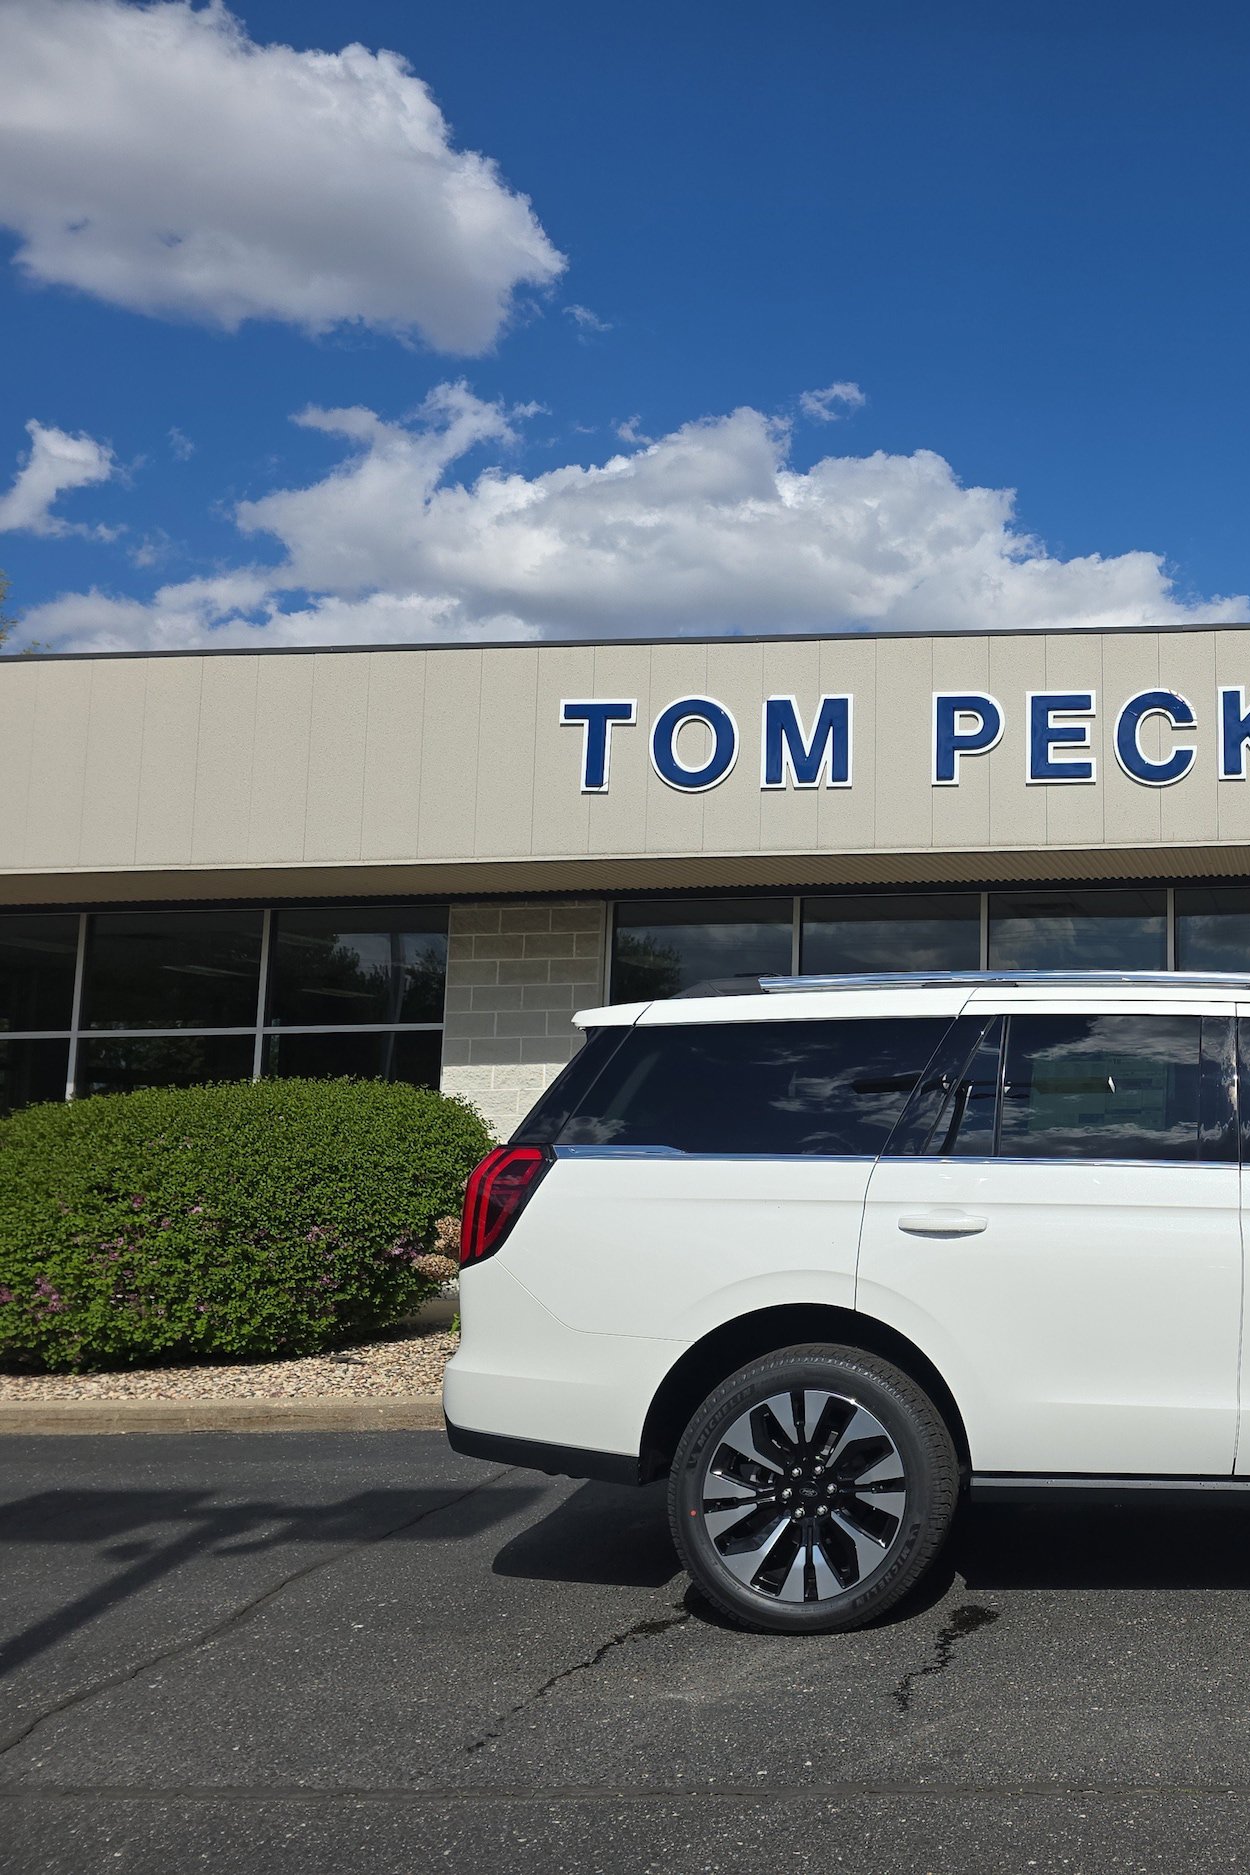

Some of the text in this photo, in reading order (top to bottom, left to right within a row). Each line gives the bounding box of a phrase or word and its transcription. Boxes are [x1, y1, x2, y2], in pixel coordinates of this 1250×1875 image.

[560, 694, 853, 793] TOM
[697, 1386, 753, 1448] MICHELIN
[855, 1545, 911, 1607] MICHELIN
